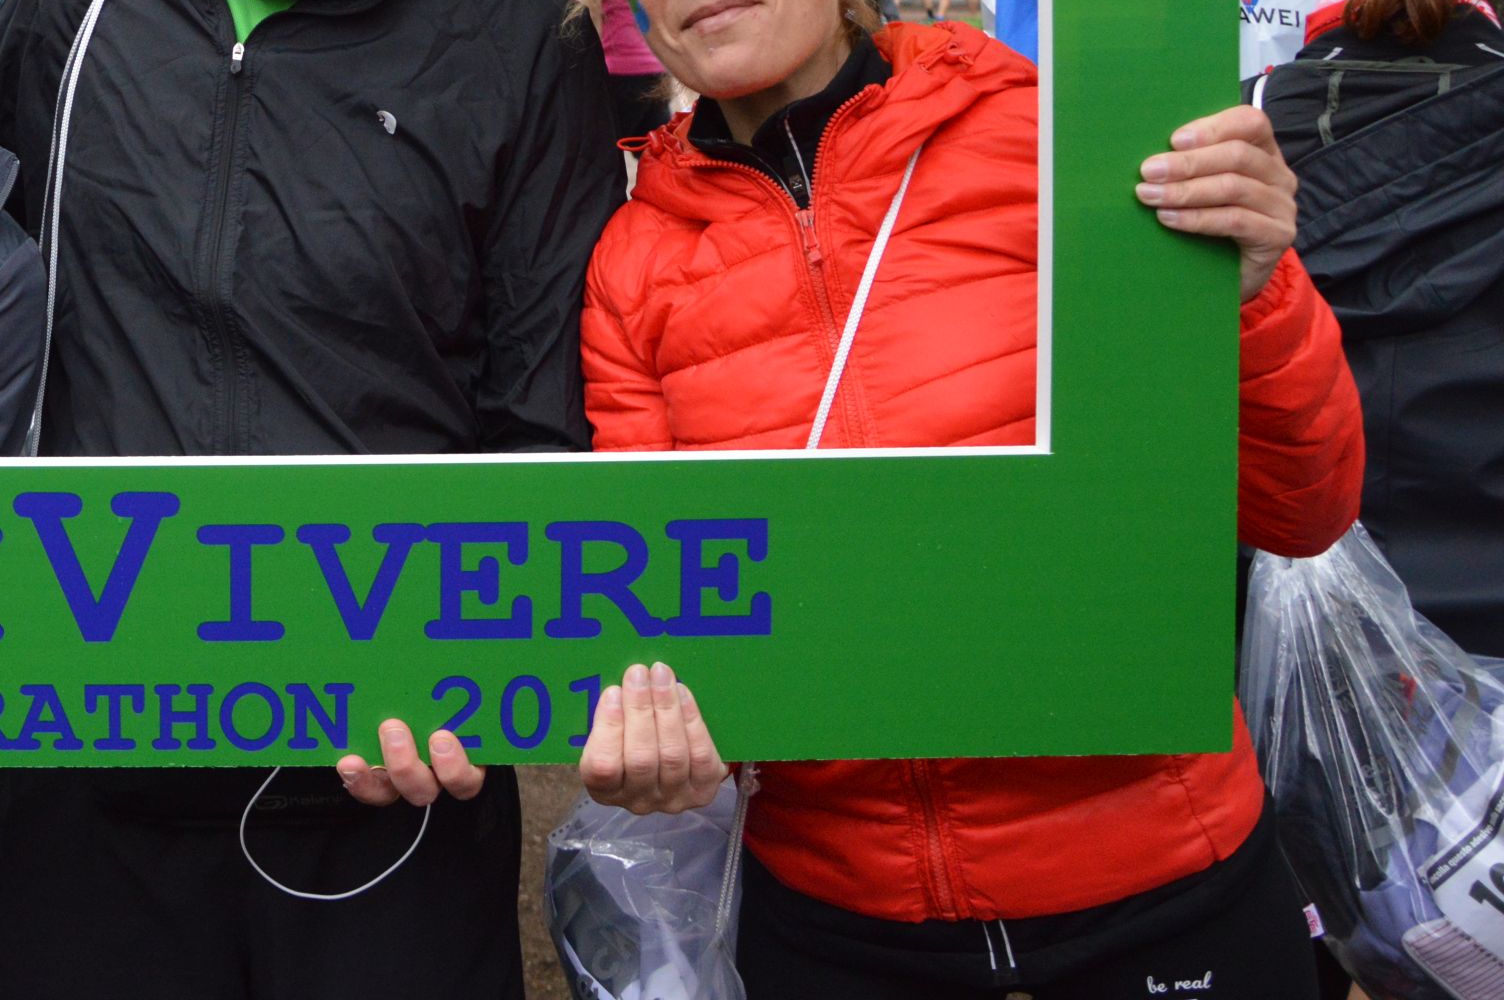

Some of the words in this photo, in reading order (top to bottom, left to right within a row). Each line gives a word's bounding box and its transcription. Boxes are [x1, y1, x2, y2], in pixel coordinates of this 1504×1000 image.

[432, 674, 681, 749] 201
[1146, 976, 1168, 994] be
[1175, 970, 1212, 990] real
